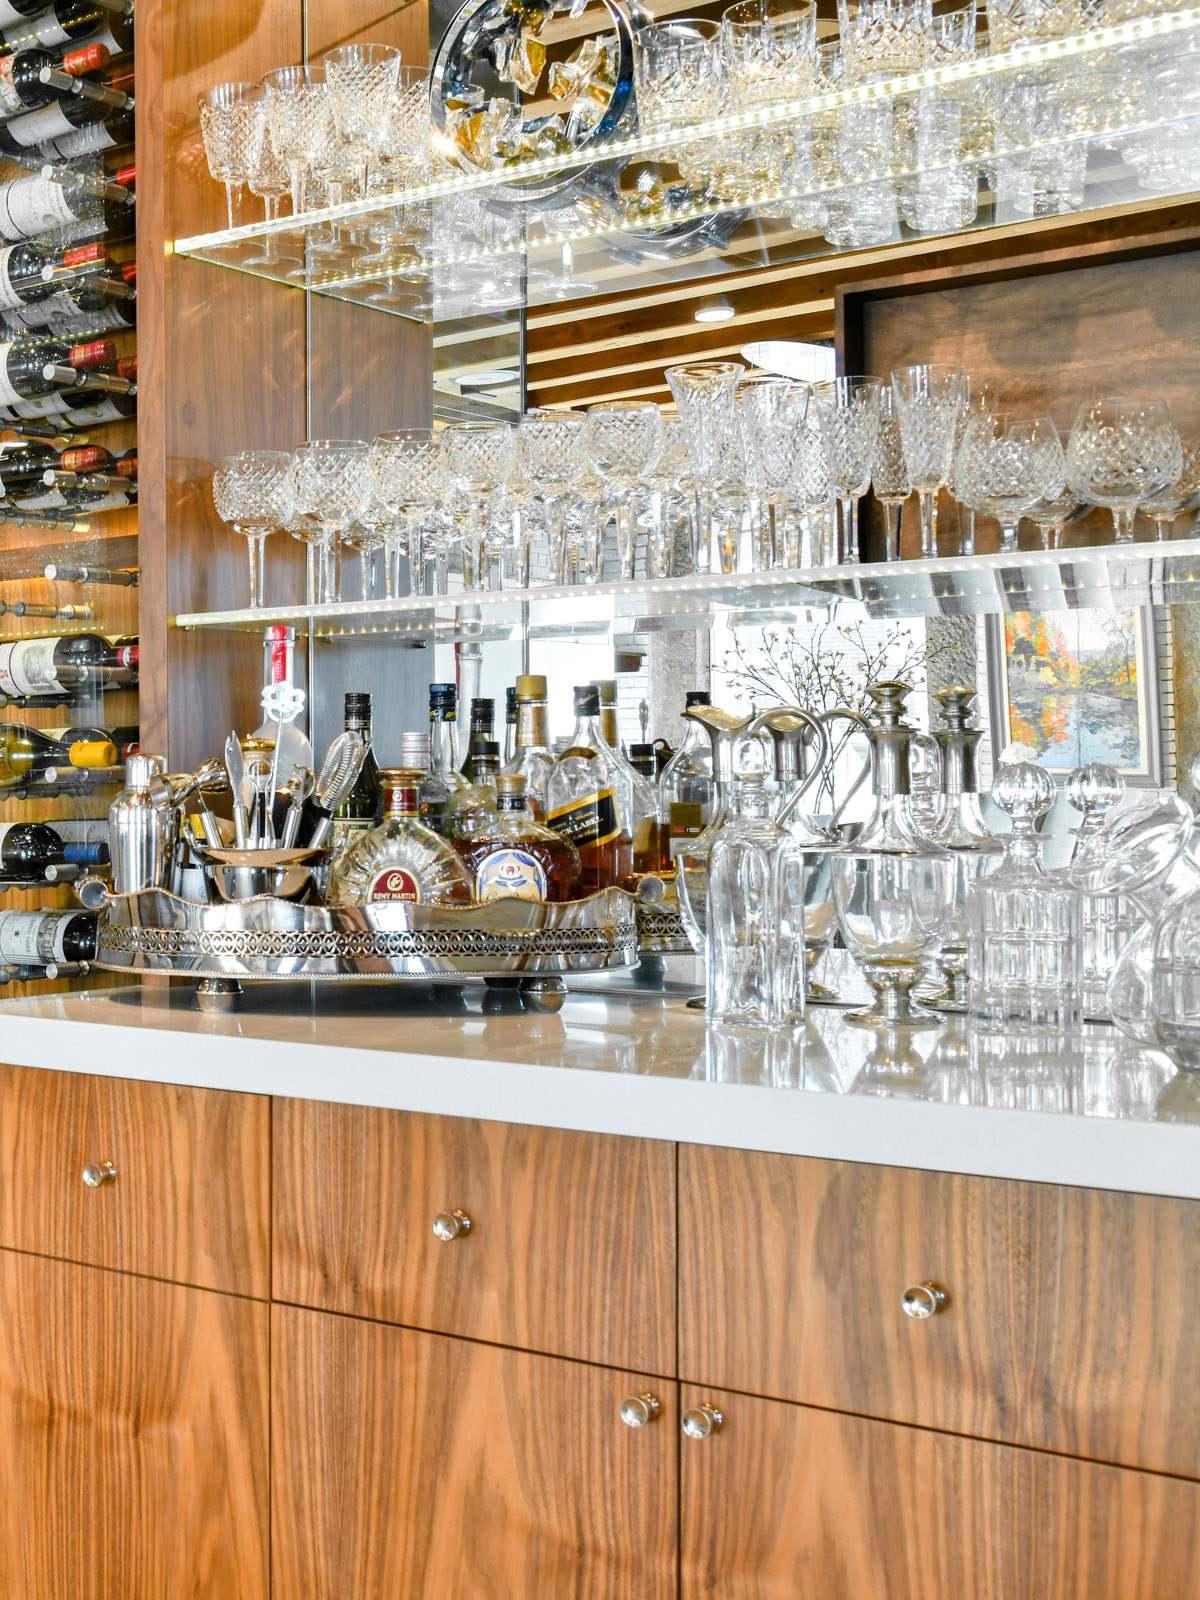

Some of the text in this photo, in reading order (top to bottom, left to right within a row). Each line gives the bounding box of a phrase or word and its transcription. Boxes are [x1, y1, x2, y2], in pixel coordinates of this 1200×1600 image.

[573, 816, 604, 833] LABEL
[373, 892, 417, 901] REMY MARTIN
